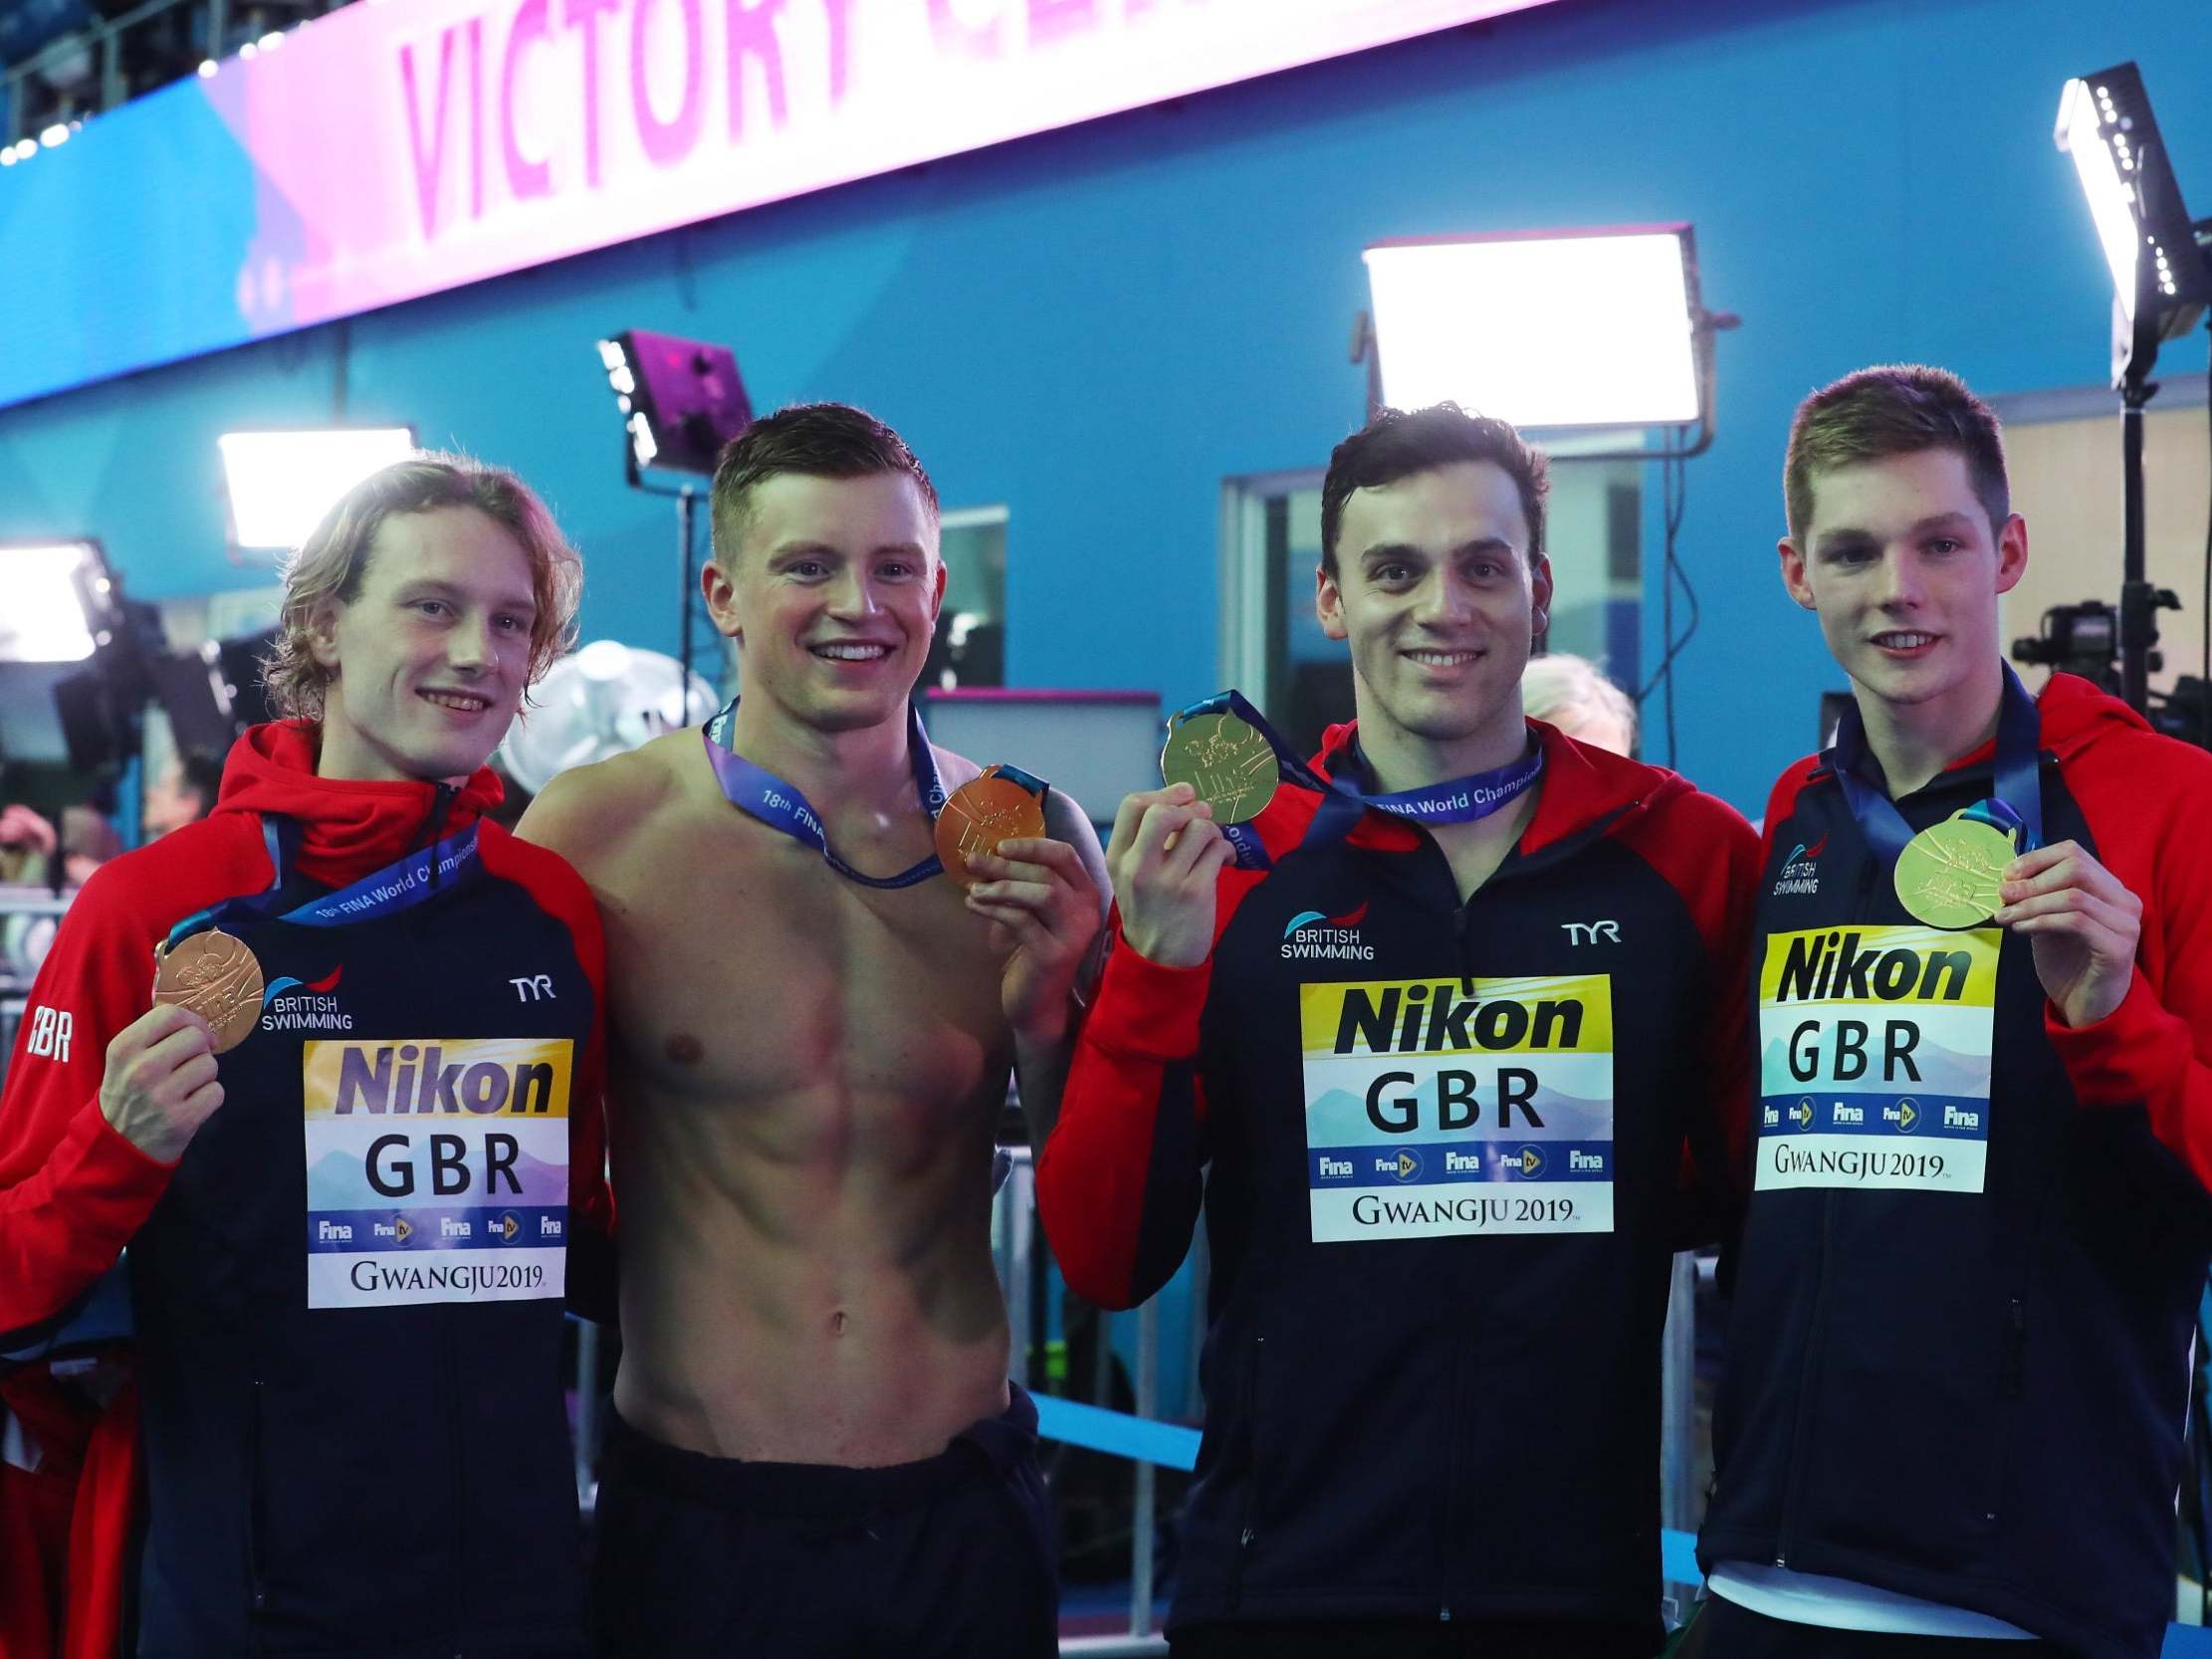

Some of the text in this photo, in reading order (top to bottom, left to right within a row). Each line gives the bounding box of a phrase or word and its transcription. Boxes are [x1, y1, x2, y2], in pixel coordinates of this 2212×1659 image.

[764, 789, 791, 812] 18th
[1418, 793, 1469, 814] World
[339, 895, 376, 915] FINA
[373, 873, 415, 901] World
[1296, 930, 1360, 943] BRITISH
[1561, 920, 1622, 945] TYR
[1281, 944, 1374, 960] SWIMMING
[1776, 932, 1973, 1003] Nikon
[508, 974, 557, 1002] TYR
[275, 996, 337, 1012] BRITISH
[262, 1014, 352, 1030] SWIMMING
[1334, 984, 1585, 1055] Nikon
[1789, 1019, 1922, 1083] GBR
[334, 1044, 553, 1116] Nikon
[1366, 1067, 1545, 1135] GBR
[365, 1133, 524, 1198] GBR
[1890, 1153, 1944, 1178] 2019
[1352, 1195, 1574, 1227] GWANGJU 2019
